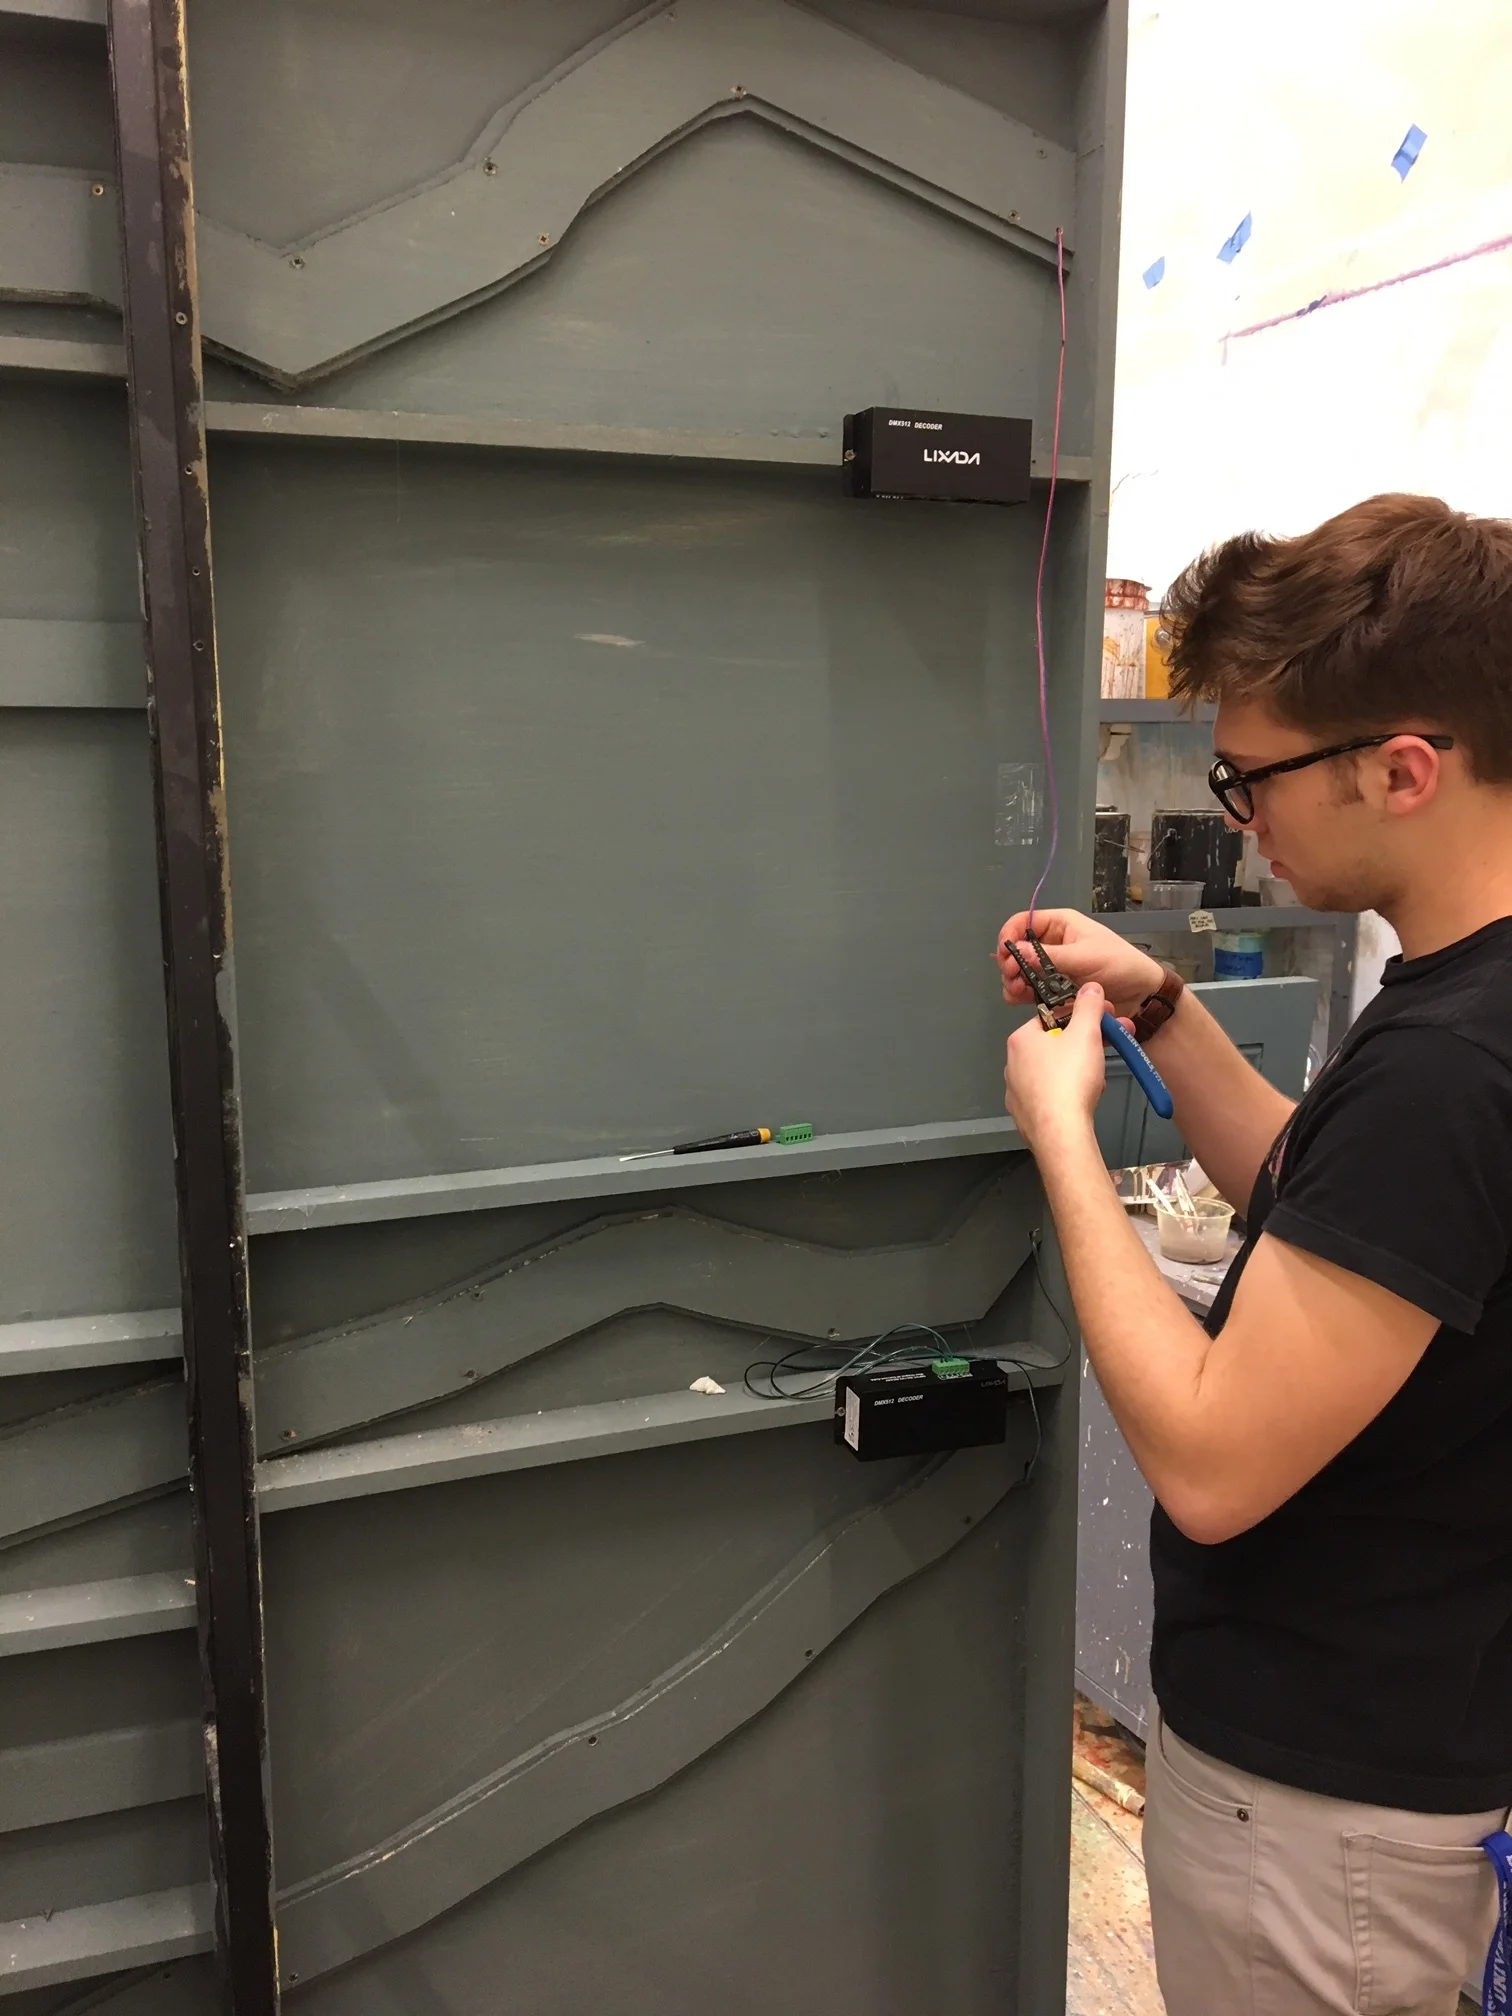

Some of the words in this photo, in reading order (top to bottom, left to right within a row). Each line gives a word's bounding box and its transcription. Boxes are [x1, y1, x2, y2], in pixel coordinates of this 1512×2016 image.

[888, 419, 911, 427] DMX512
[914, 422, 943, 430] DECODER
[923, 448, 981, 465] LIXADA
[1119, 1025, 1139, 1048] KLEIN
[874, 1398, 895, 1406] DMX512
[897, 1394, 924, 1403] DECODER
